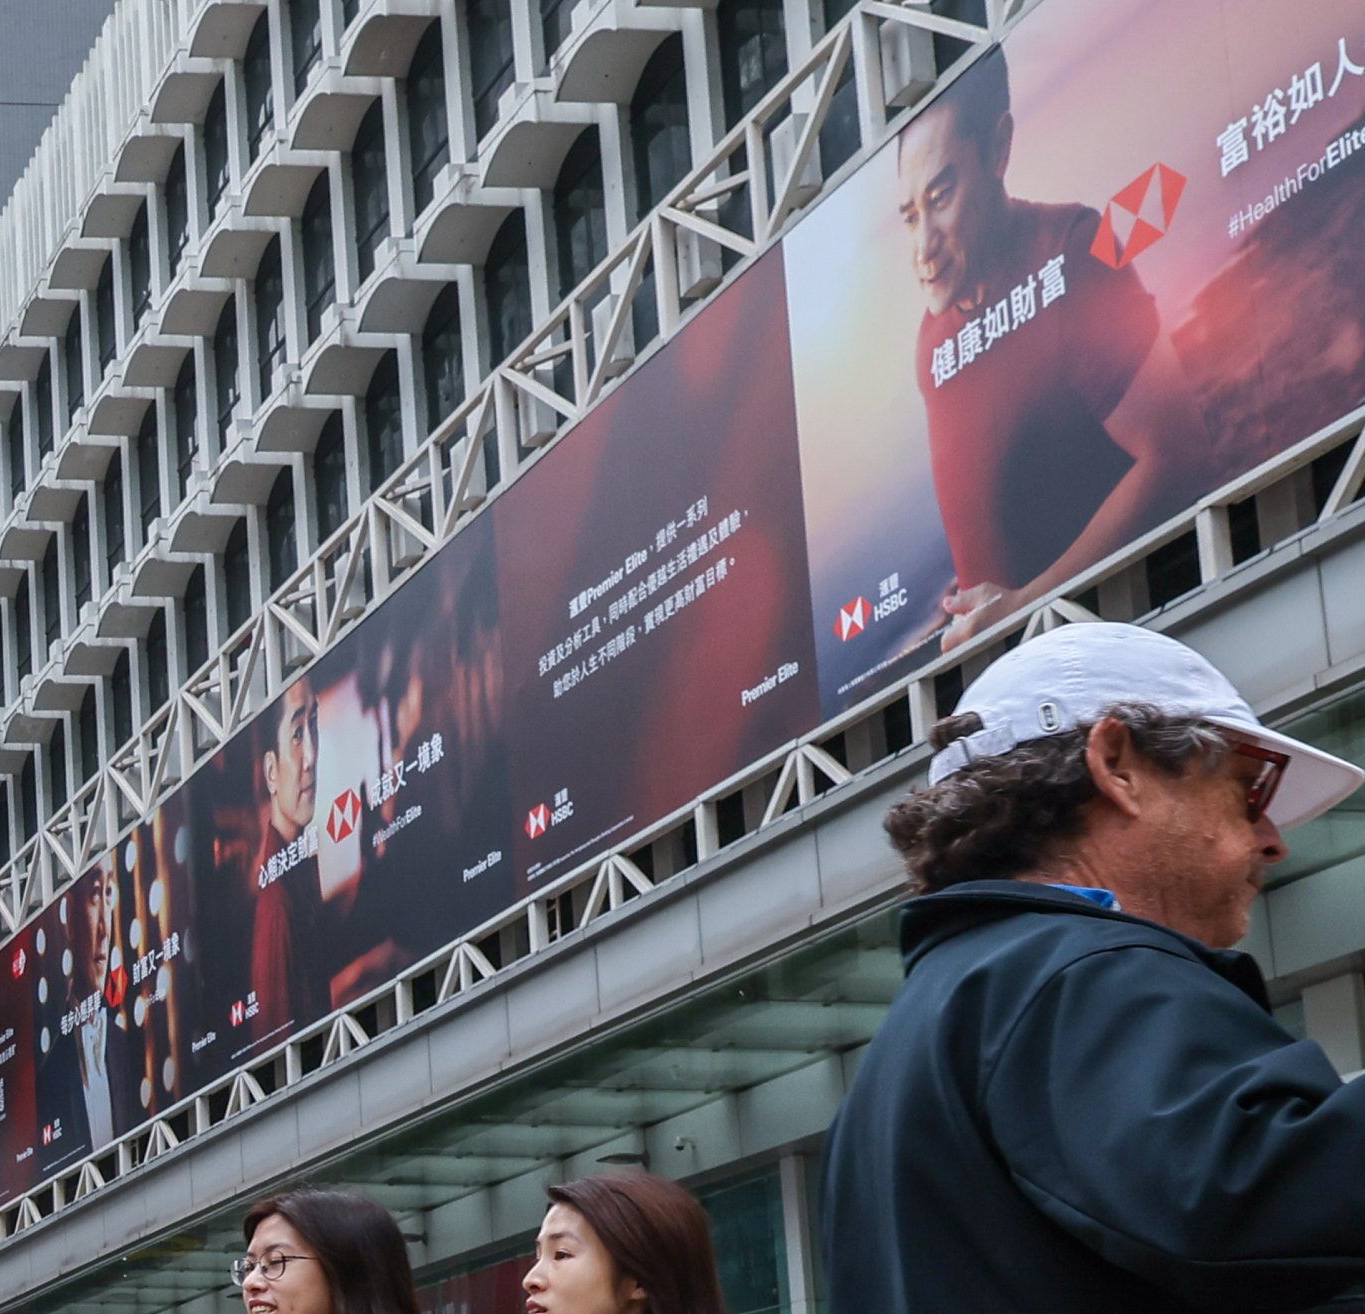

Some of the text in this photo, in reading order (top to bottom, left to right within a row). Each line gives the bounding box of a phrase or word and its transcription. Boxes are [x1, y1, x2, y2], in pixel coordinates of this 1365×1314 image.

[930, 254, 1067, 388] 健康如財富
[873, 588, 907, 622] HSBC
[741, 661, 798, 706] Premier Elite
[550, 801, 574, 826] HSBC
[463, 850, 502, 882] Premier Elite
